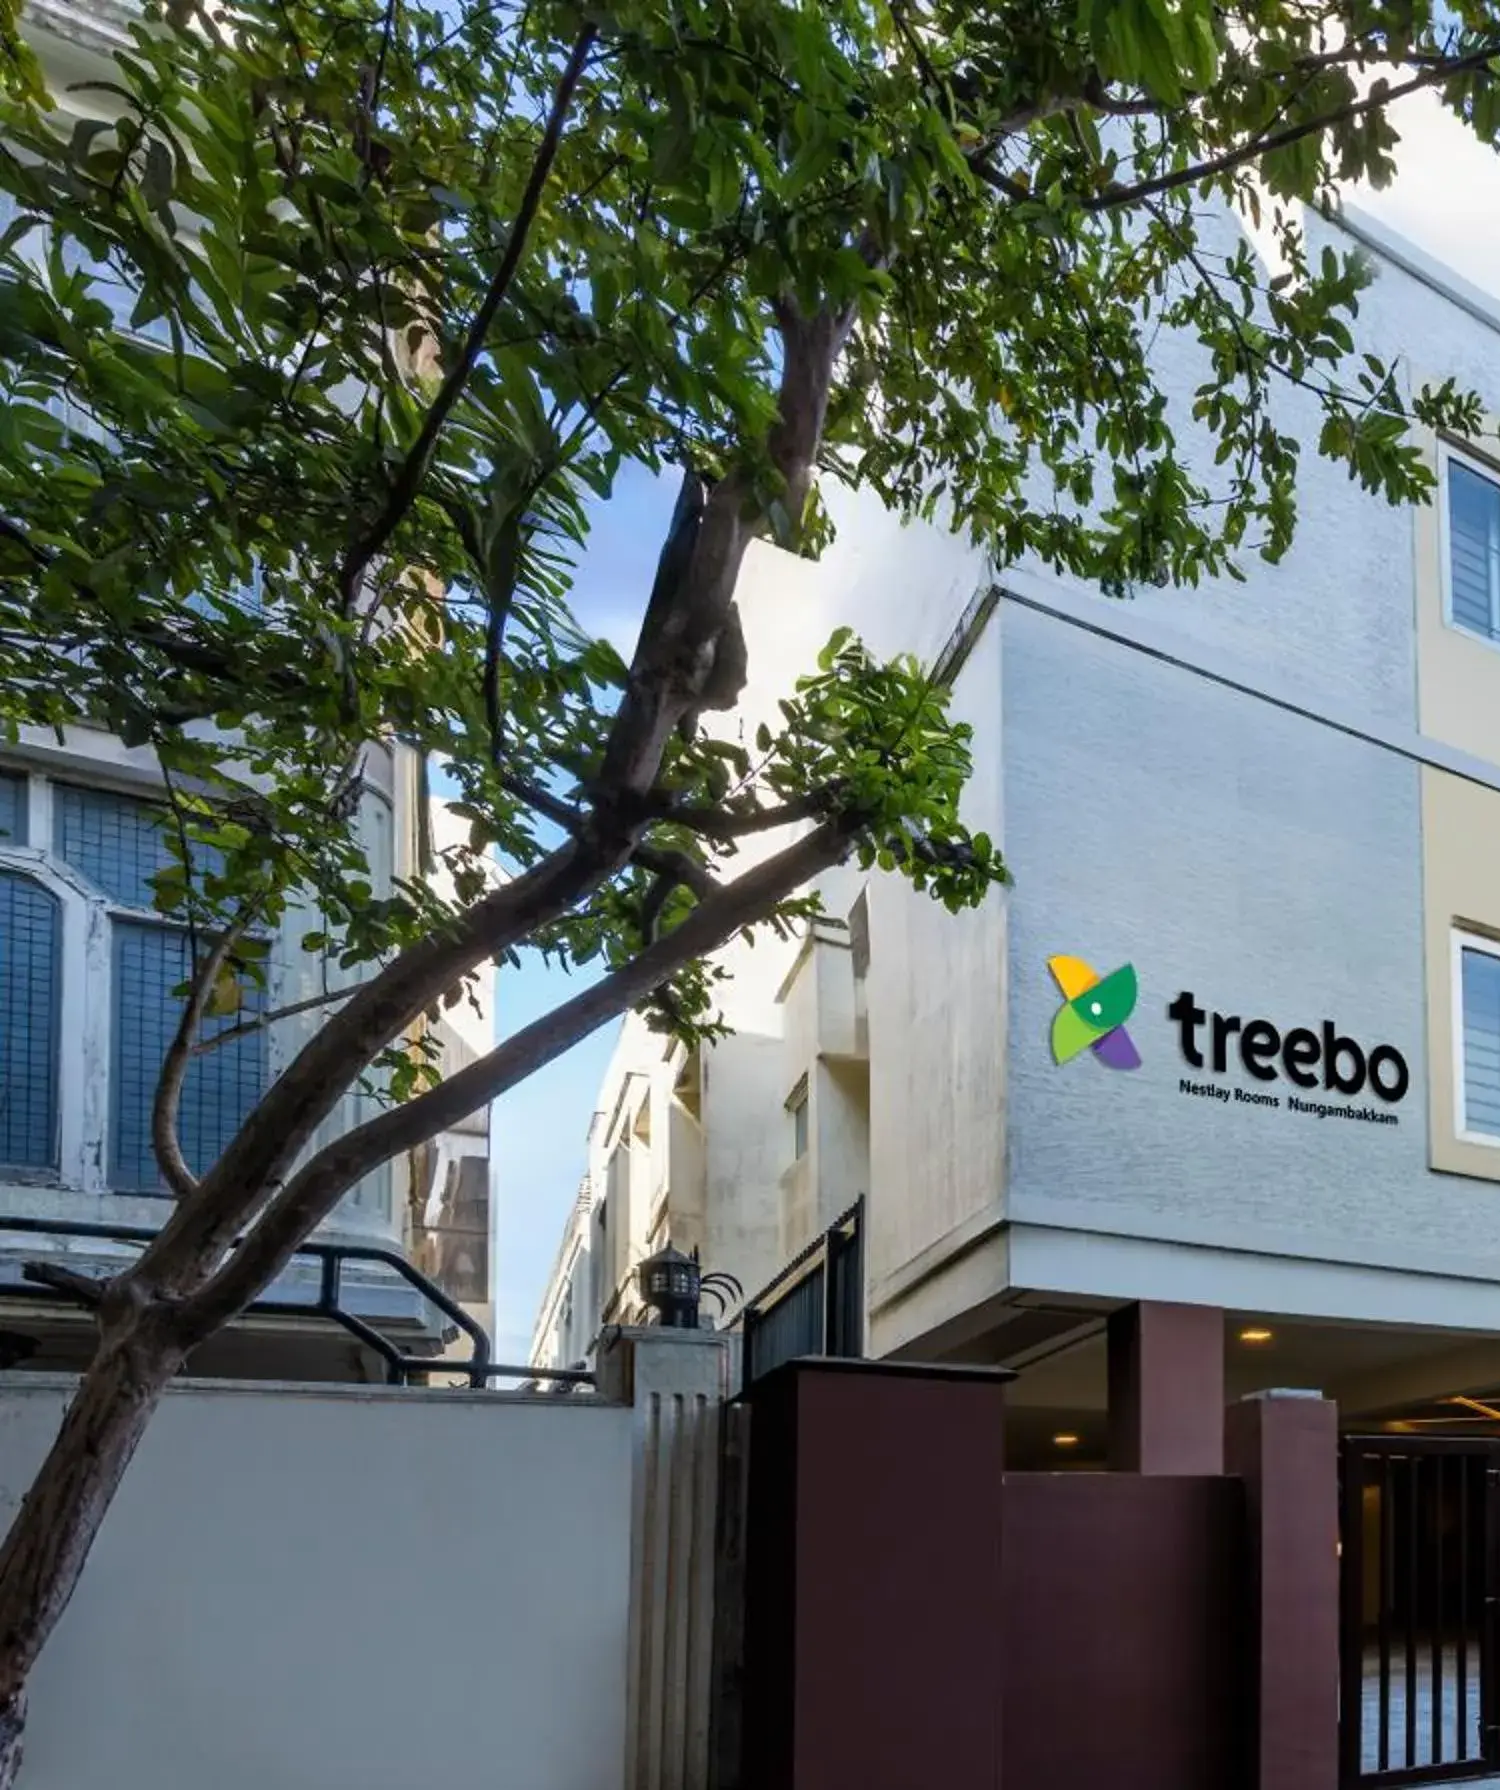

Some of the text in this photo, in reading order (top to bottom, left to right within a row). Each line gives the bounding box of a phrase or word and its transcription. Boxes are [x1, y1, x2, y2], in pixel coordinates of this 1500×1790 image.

[1168, 991, 1410, 1102] treebo
[1179, 1079, 1399, 1125] Nestlay Rooms Nungambakkam
